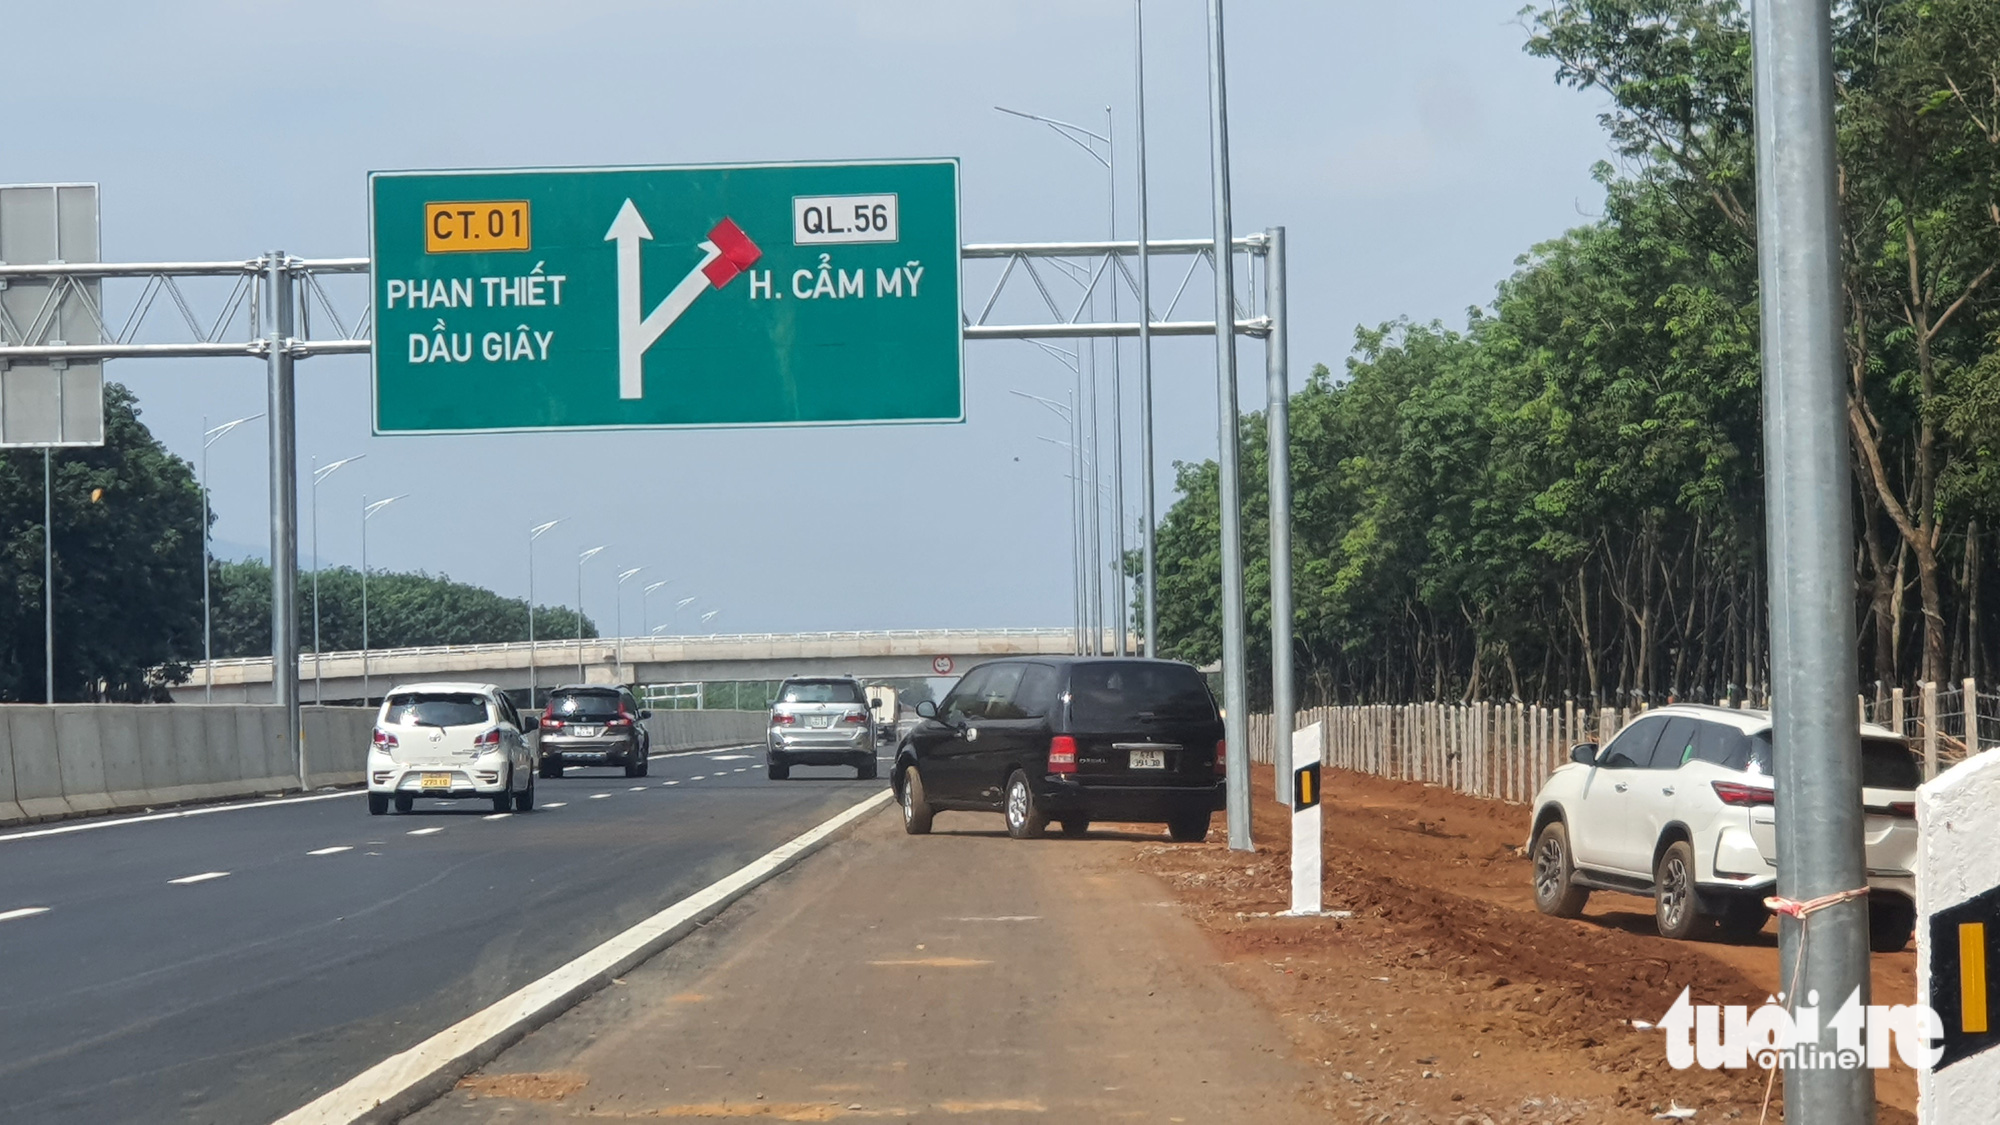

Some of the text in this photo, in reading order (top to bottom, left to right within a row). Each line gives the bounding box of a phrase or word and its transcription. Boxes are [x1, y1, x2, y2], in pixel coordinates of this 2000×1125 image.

[433, 209, 520, 240] CT.01
[803, 204, 888, 234] QL.56
[386, 260, 566, 309] PHAN THIẾT
[750, 253, 924, 300] H. CẨM MỸ
[408, 318, 554, 363] DẦU GIÂY
